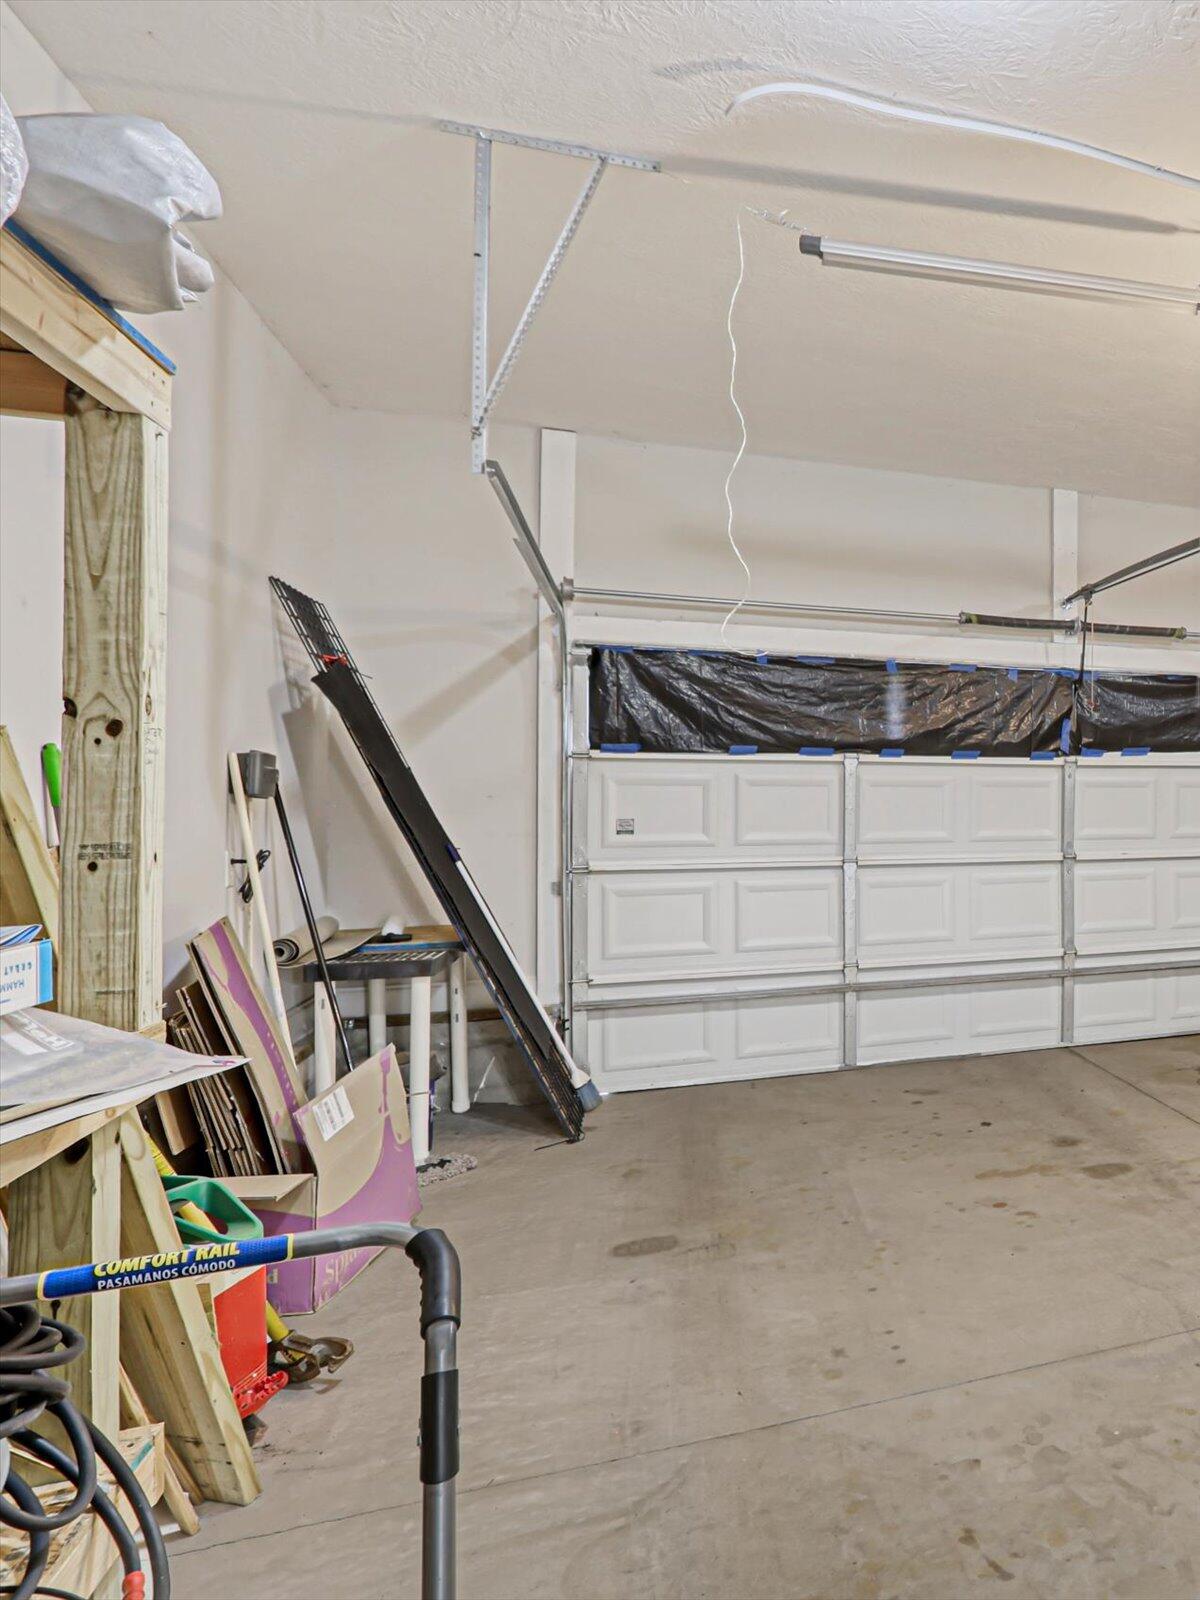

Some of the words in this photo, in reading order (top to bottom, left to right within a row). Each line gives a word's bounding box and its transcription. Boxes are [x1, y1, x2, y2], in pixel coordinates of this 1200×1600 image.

[93, 1249, 189, 1277] COMFORT
[196, 1241, 240, 1260] RAIL
[97, 1267, 179, 1291] PASAMANOS
[181, 1259, 236, 1277] CÓMODO
